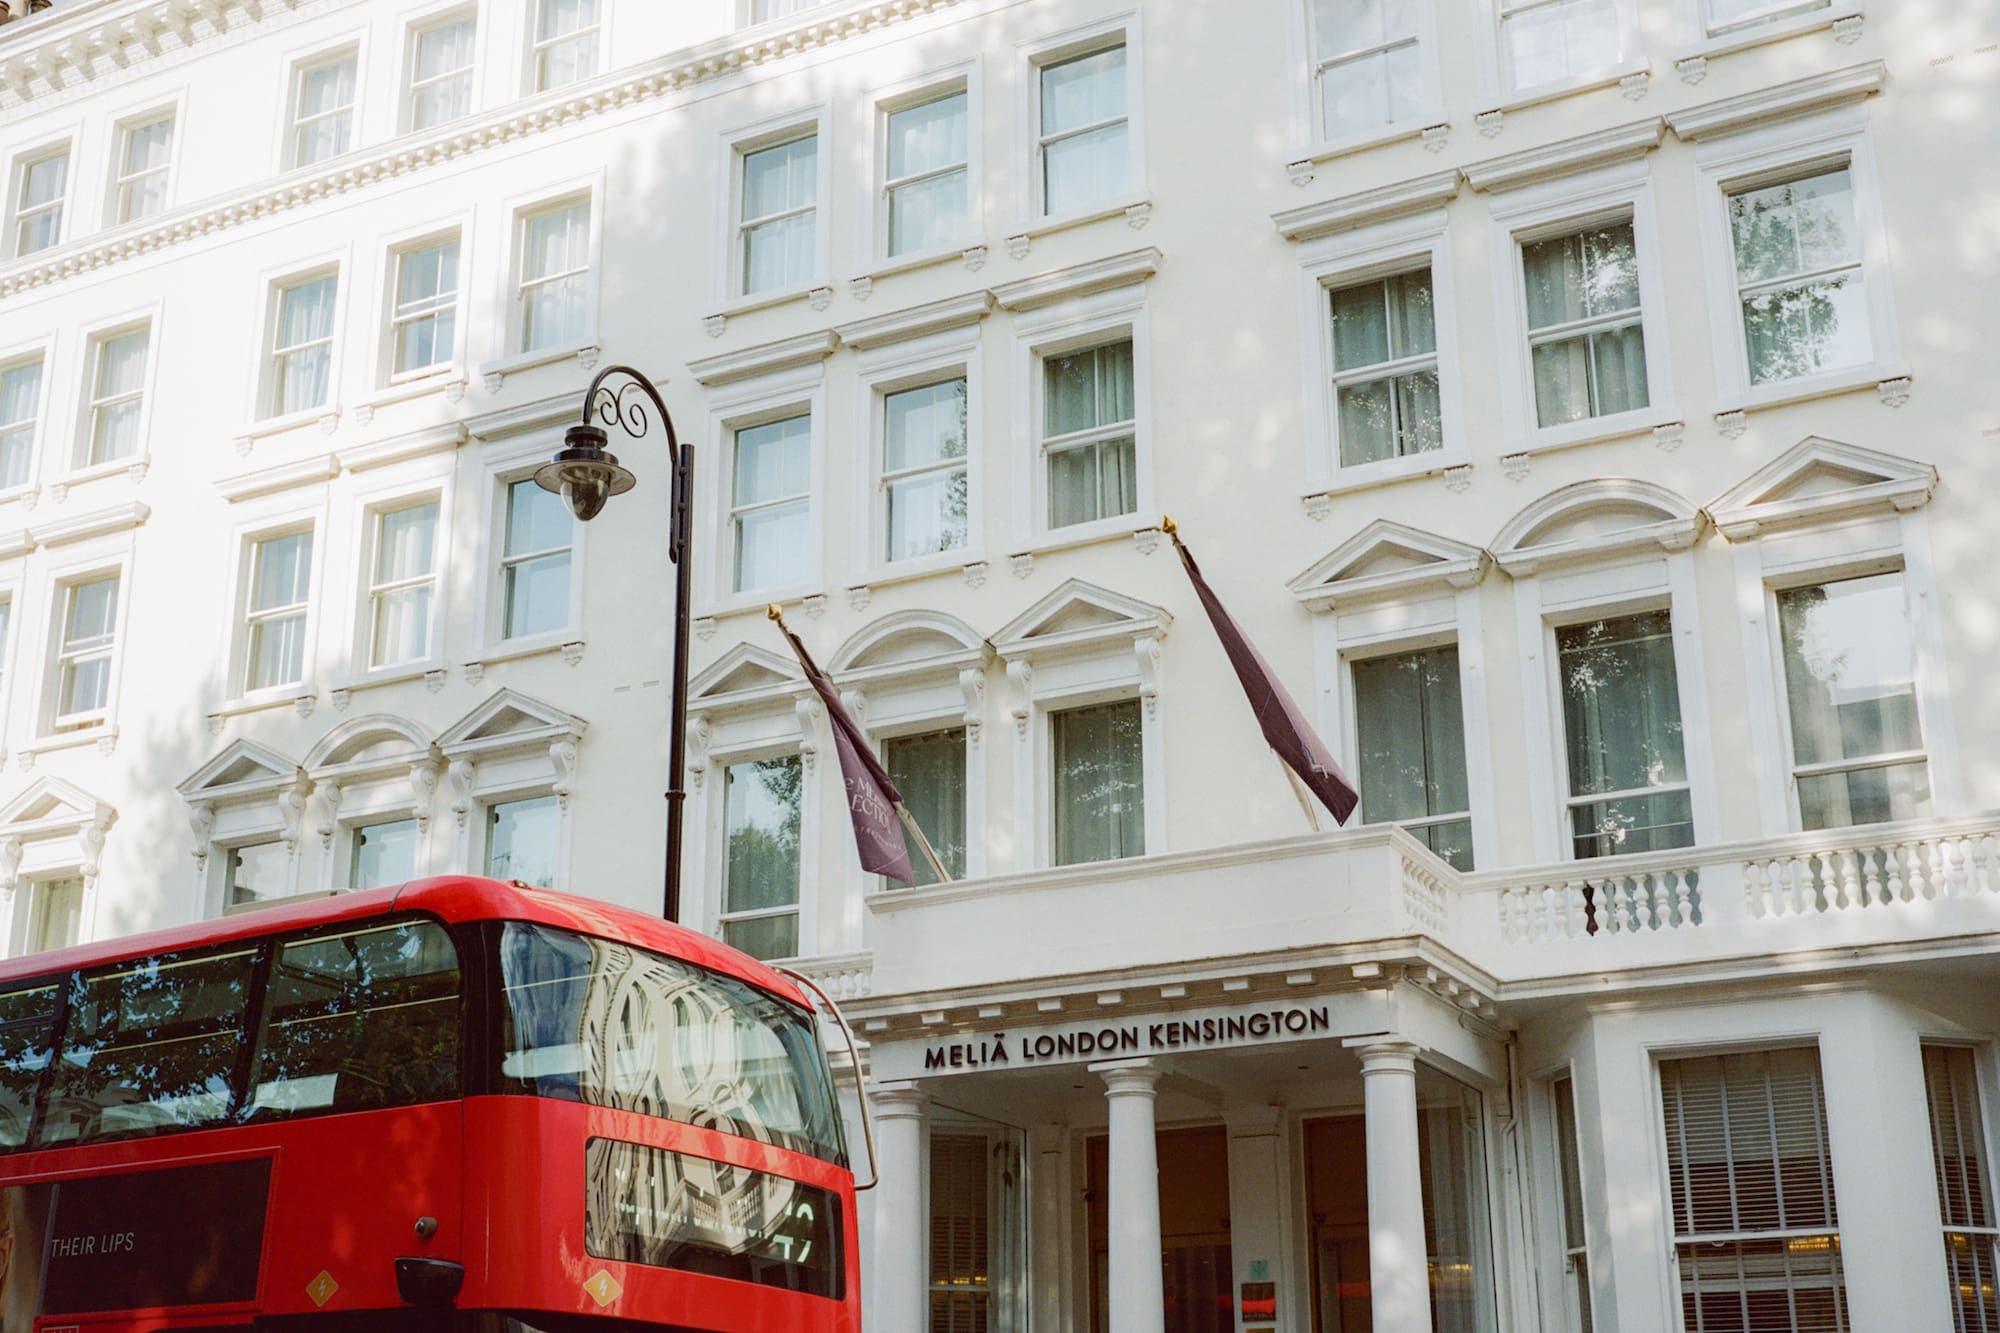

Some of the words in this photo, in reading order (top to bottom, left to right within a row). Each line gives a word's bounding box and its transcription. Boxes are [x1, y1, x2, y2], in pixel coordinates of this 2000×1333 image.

[1023, 1026, 1139, 1060] LONDON
[1149, 1006, 1330, 1047] KENSINGTON
[51, 1235, 95, 1257] THEIR
[101, 1232, 135, 1253] LIPS
